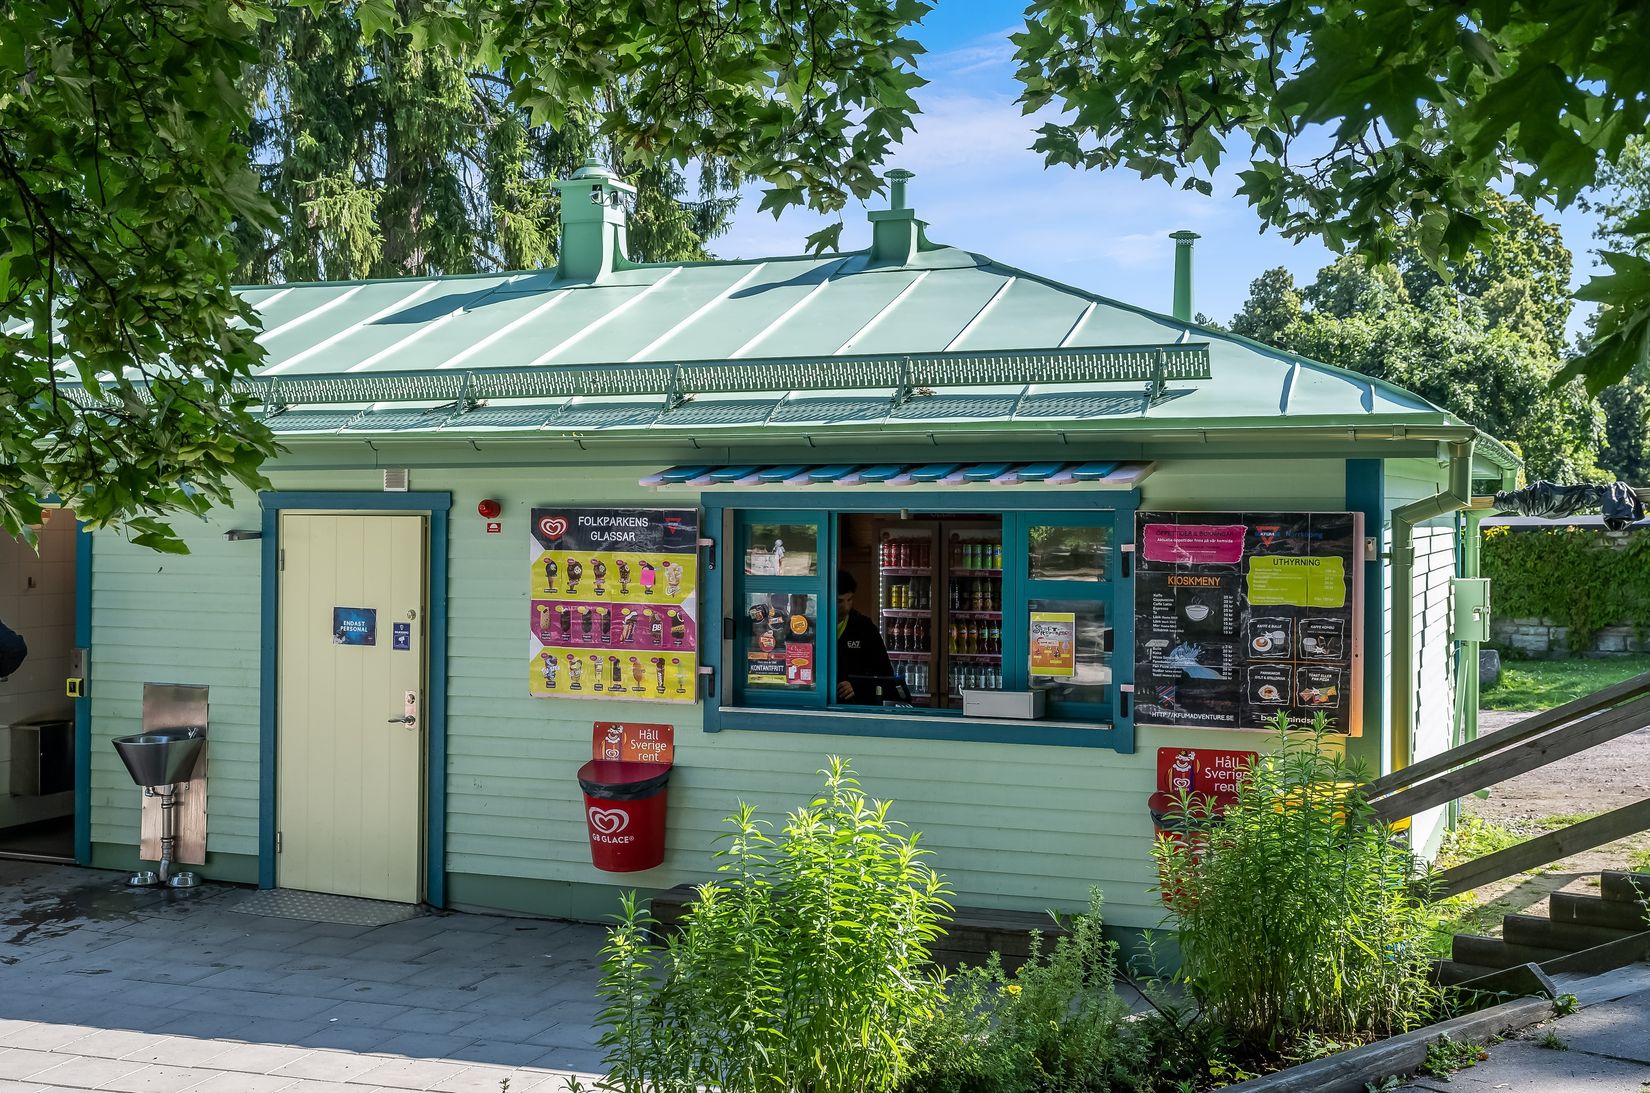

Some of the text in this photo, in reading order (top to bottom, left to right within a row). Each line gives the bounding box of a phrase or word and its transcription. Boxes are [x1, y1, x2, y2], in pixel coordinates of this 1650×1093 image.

[578, 516, 649, 527] FOLKPARKENS
[590, 531, 636, 542] GLASSAR
[1168, 576, 1220, 586] KIOSKMENY
[639, 728, 659, 740] Håll
[630, 739, 667, 751] Sverige
[638, 752, 659, 762] rent
[1215, 756, 1239, 768] Håll
[592, 833, 600, 842] GB
